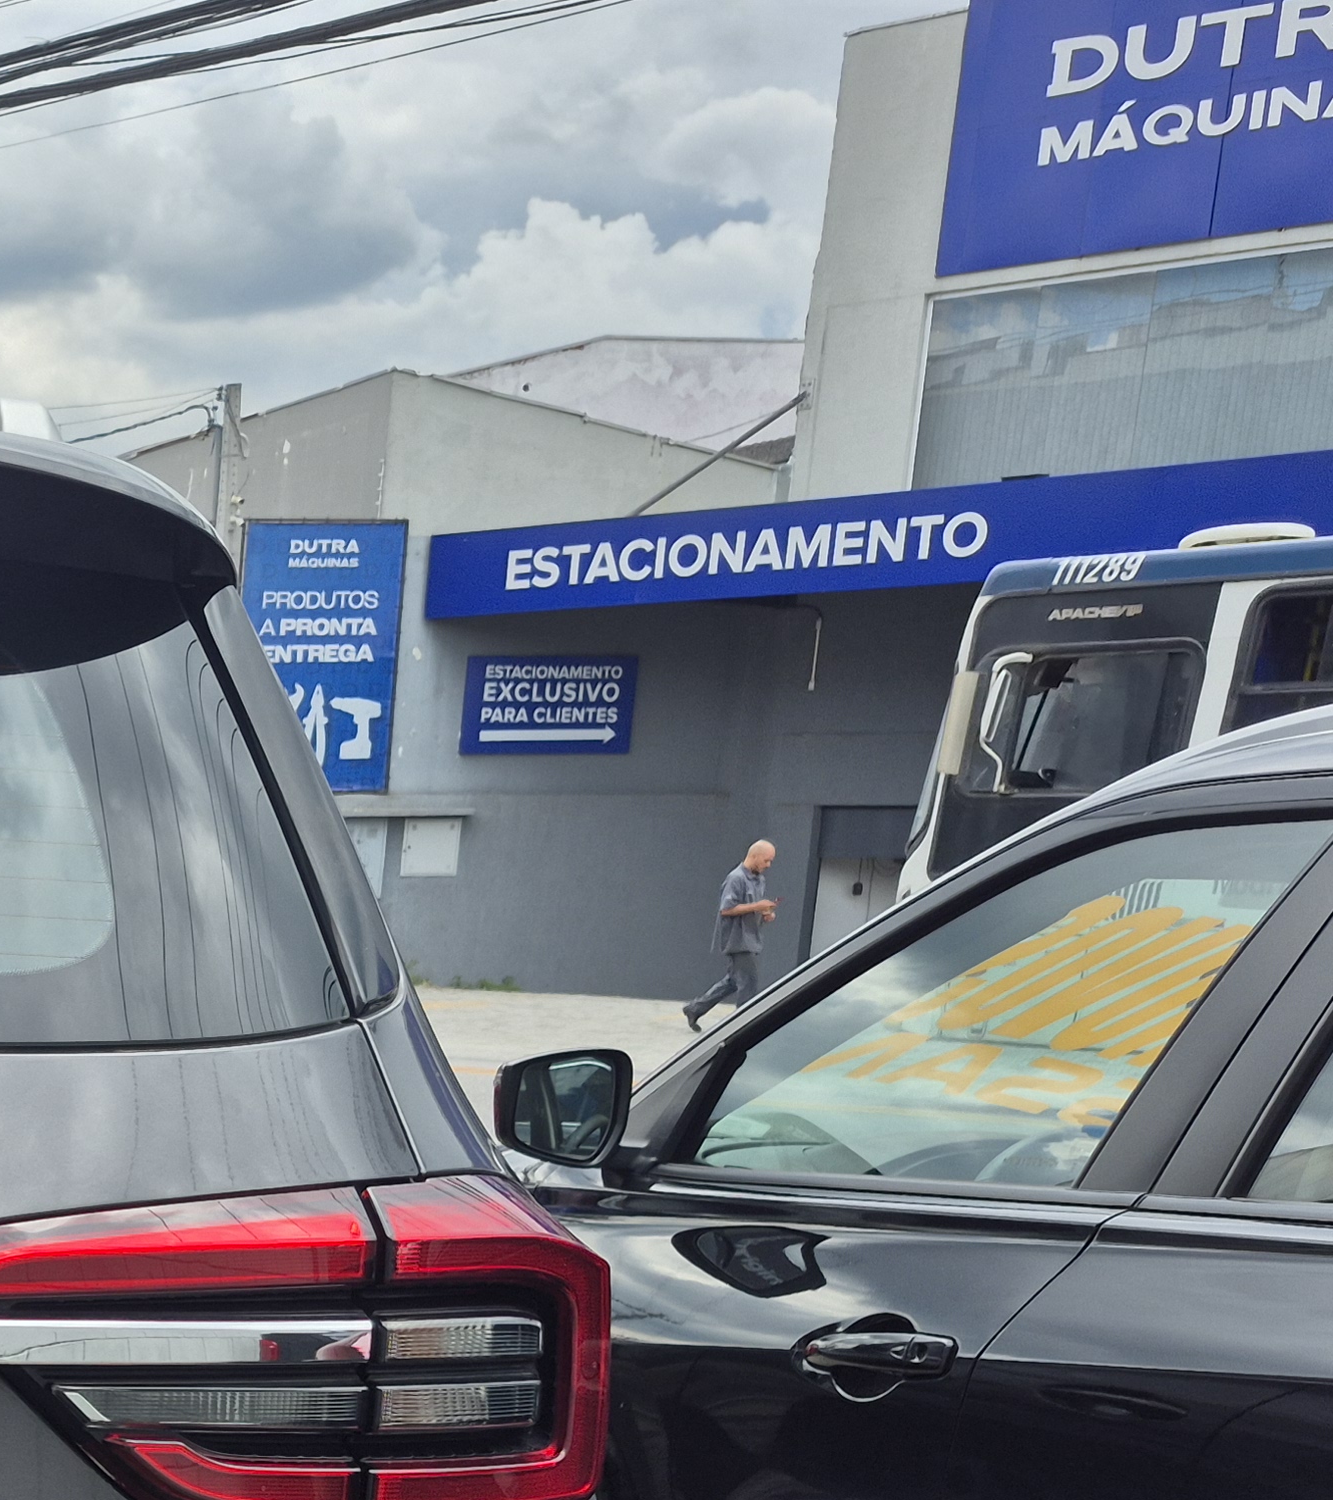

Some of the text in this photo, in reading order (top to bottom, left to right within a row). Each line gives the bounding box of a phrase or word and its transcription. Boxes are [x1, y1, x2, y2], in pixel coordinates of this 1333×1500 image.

[1046, 0, 1333, 97] DUTR
[1037, 80, 1333, 166] MÁQUIN
[289, 539, 360, 554] DUTRA
[505, 511, 988, 590] ESTACIONAMENTO
[288, 555, 359, 568] MÁQUINAS
[1052, 554, 1146, 585] 111289
[262, 590, 379, 610] PRODUTOS
[259, 617, 377, 636] A PRONTA
[263, 644, 374, 664] ENTREGA
[485, 664, 623, 680] ESTACIONAMENTO
[482, 681, 620, 703] EXCLUSIVO
[480, 706, 619, 723] PARA CLIENTES
